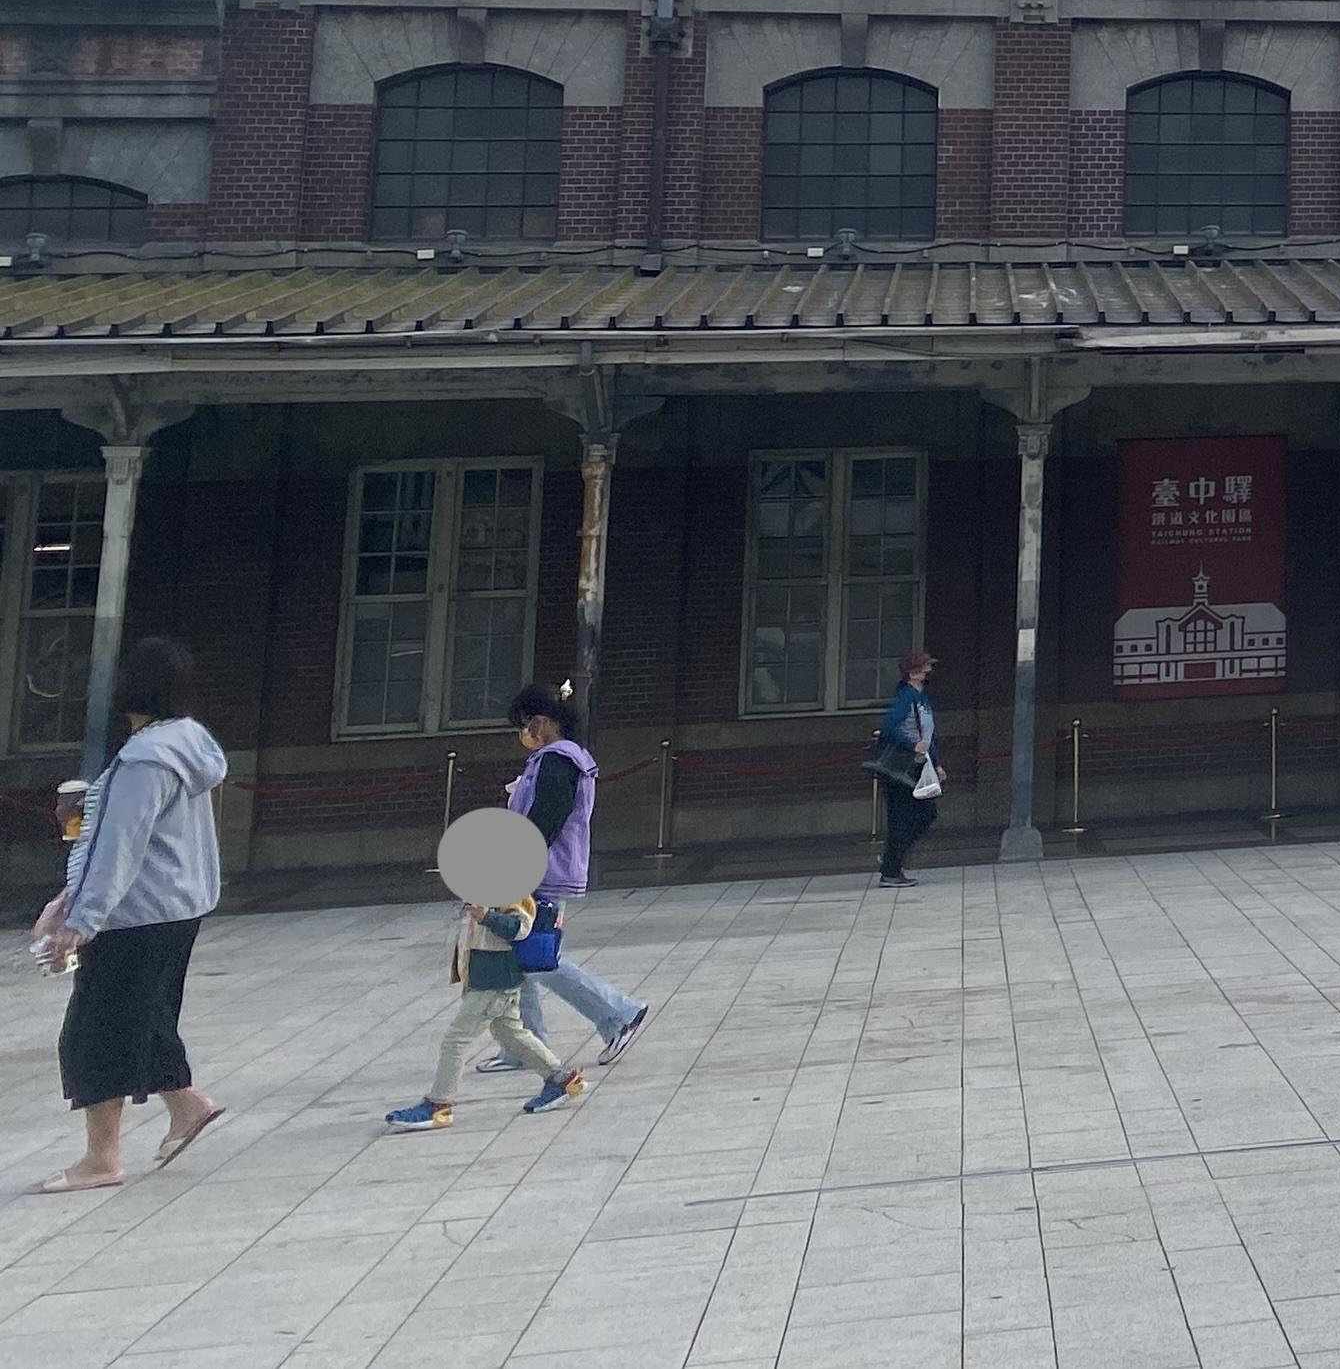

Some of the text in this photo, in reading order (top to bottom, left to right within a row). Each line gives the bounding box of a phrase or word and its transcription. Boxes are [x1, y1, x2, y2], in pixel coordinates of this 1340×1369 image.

[1152, 475, 1253, 507] 臺中驛
[1152, 530, 1203, 538] TAICHUNG
